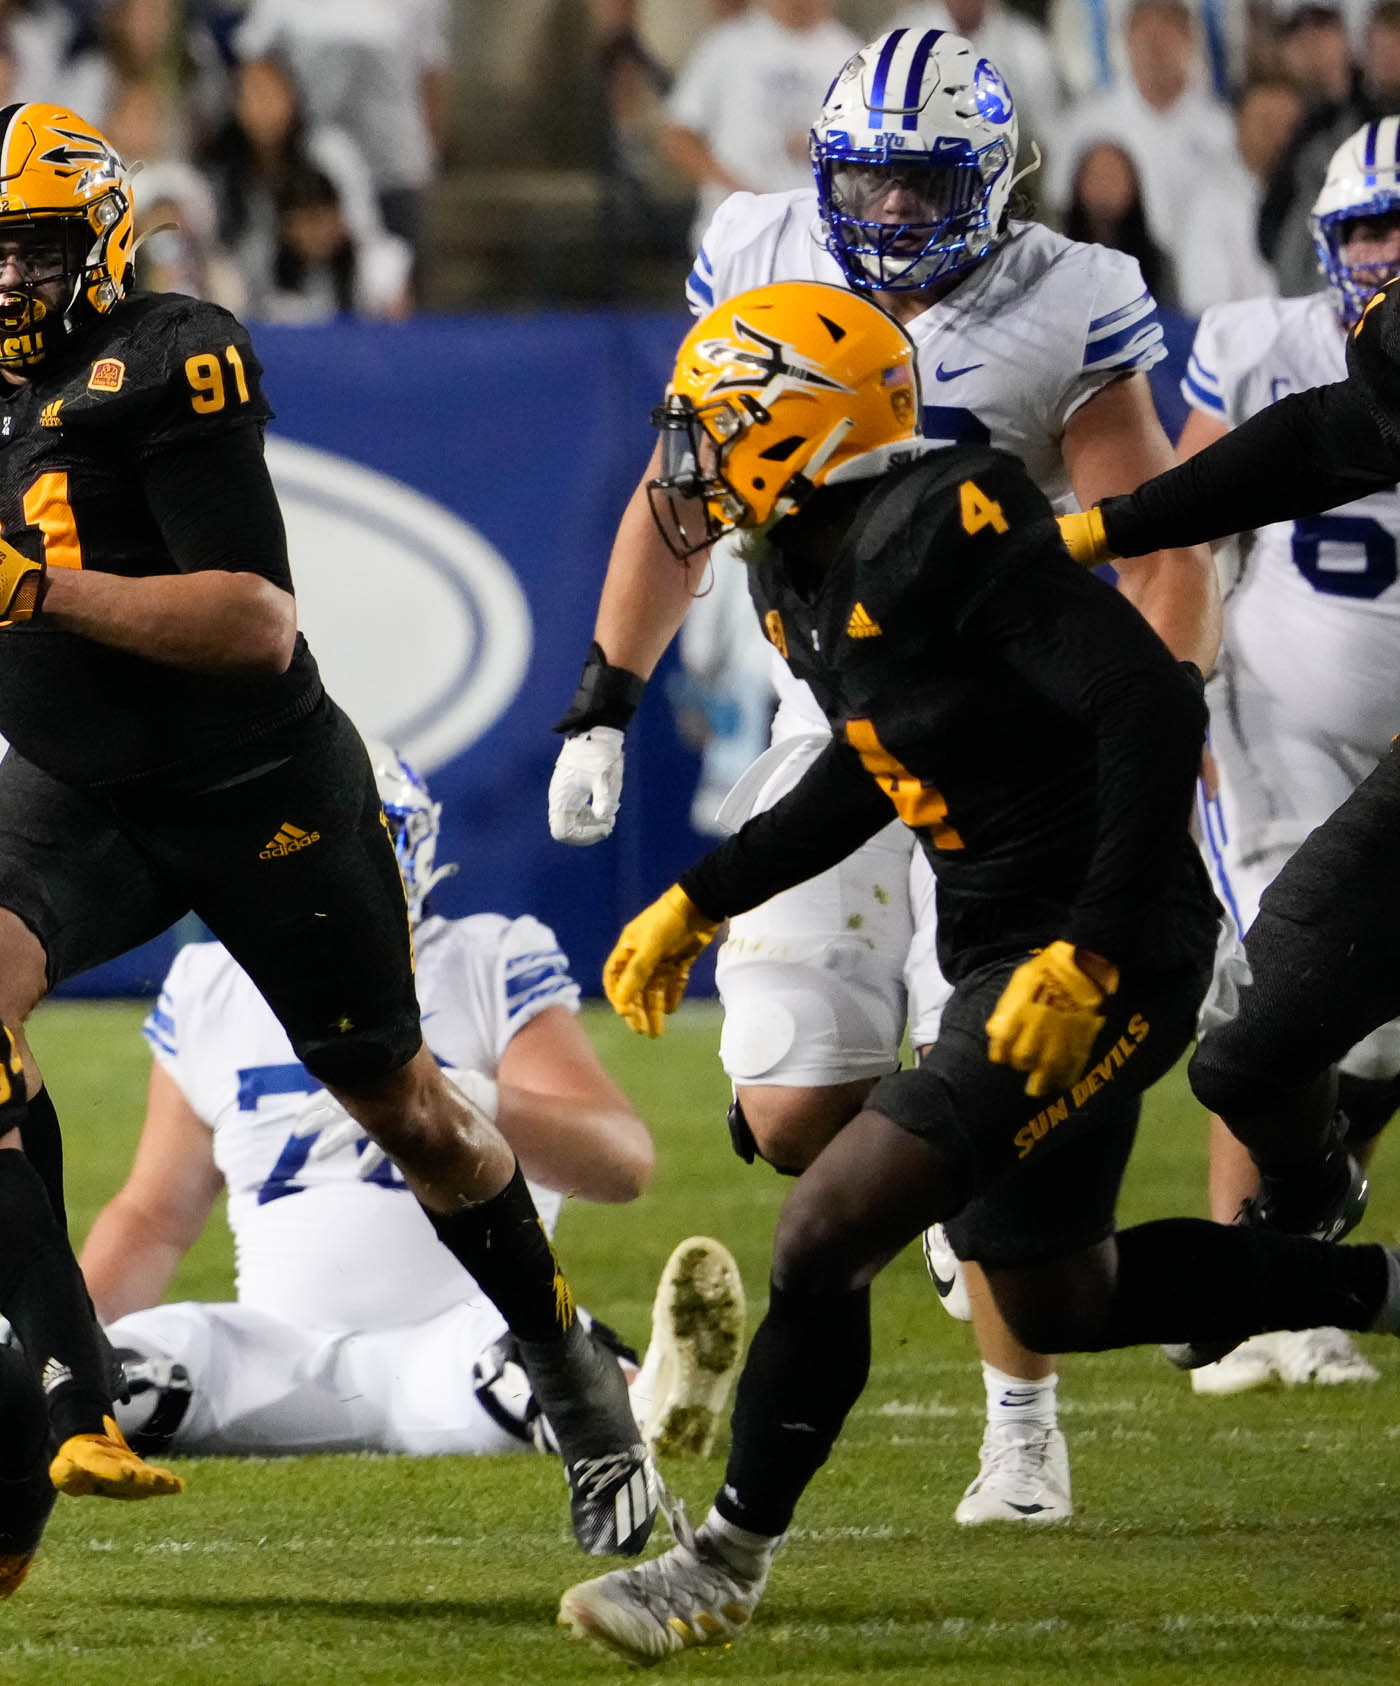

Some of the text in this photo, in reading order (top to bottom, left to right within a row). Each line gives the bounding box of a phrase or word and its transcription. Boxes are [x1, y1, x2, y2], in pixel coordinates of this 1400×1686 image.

[874, 132, 906, 149] BYU
[185, 344, 249, 414] 91
[960, 480, 1009, 536] 4
[845, 718, 967, 850] 4
[258, 831, 321, 860] adidas
[1013, 1012, 1150, 1159] SUN DEVILS
